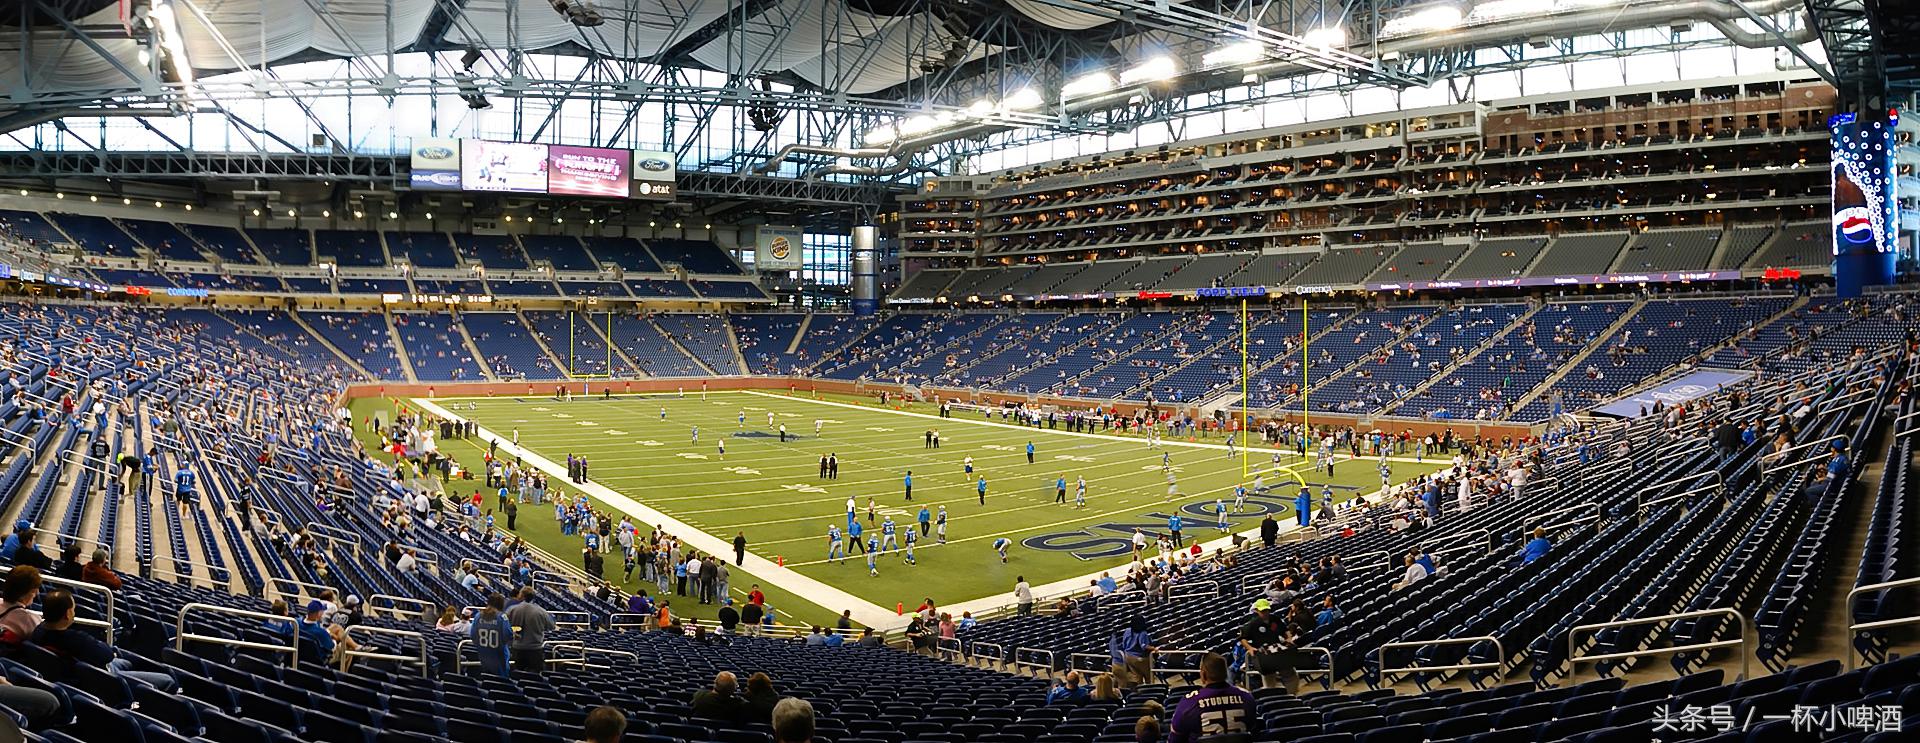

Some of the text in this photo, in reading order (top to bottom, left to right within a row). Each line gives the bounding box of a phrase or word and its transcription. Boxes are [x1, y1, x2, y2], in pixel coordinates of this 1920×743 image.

[1196, 285, 1266, 297] FORD FIELD
[478, 628, 499, 649] 80
[1198, 695, 1244, 708] STUDWELL
[1200, 708, 1247, 737] 55
